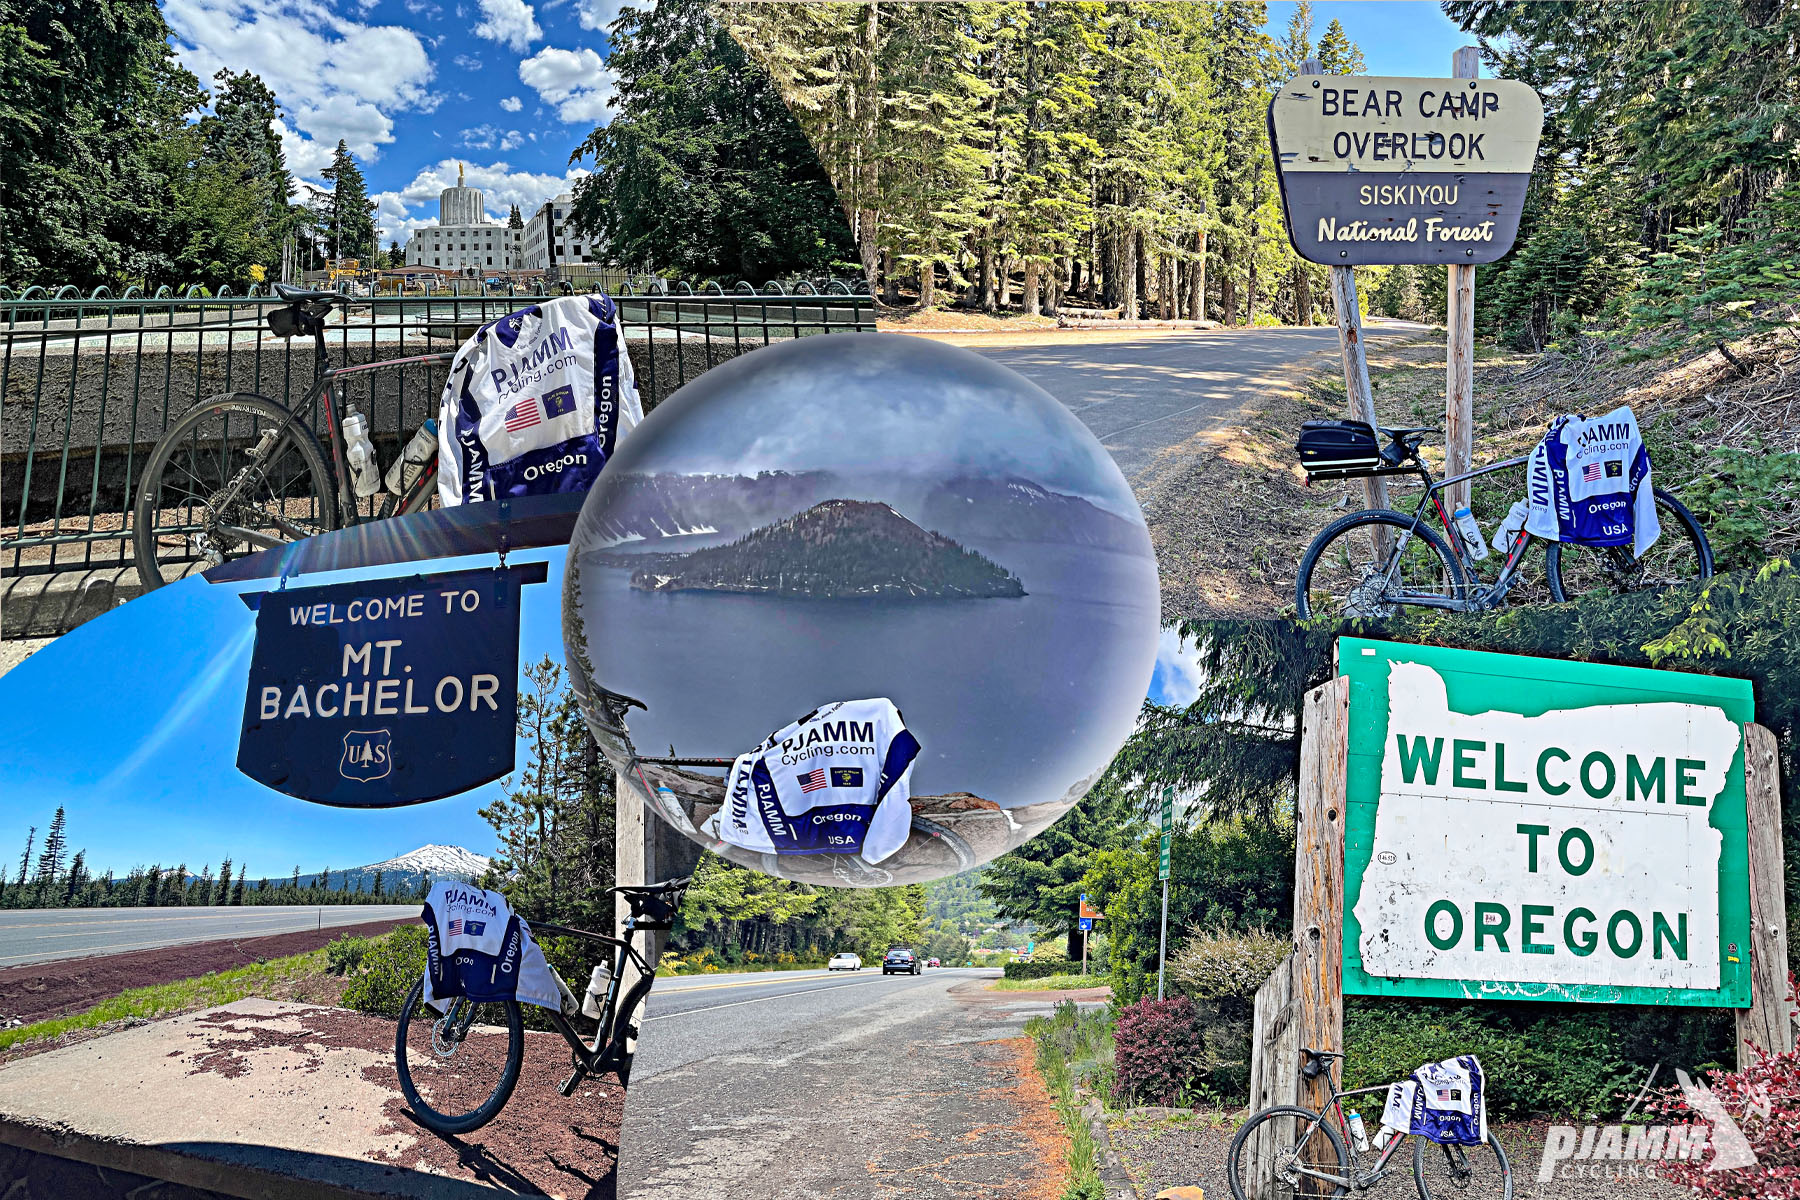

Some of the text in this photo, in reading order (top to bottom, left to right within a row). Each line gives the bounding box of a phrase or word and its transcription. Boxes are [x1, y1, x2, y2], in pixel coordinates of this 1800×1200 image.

[1322, 88, 1500, 119] BEAR CAMP
[1333, 131, 1485, 161] OVERLOOK
[1359, 184, 1458, 206] SISKIYOU
[1317, 217, 1495, 242] National Forest
[491, 327, 574, 393] PJAMM
[523, 453, 588, 481] Oregon
[1588, 501, 1627, 514] Oregon
[1602, 523, 1628, 536] USA
[290, 589, 480, 626] WELCOME TO
[341, 639, 412, 677] MT.
[259, 673, 500, 720] BACHELOR
[782, 720, 874, 754] PJAMM
[781, 744, 875, 766] Cycling.com
[1396, 734, 1707, 807] WELCOME
[757, 783, 788, 836] PJAMM
[812, 812, 862, 825] Oregon
[828, 835, 856, 846] USA
[1516, 823, 1595, 876] TO
[445, 889, 497, 916] PJAMM
[1424, 899, 1688, 961] OREGON
[500, 930, 521, 974] Oregon
